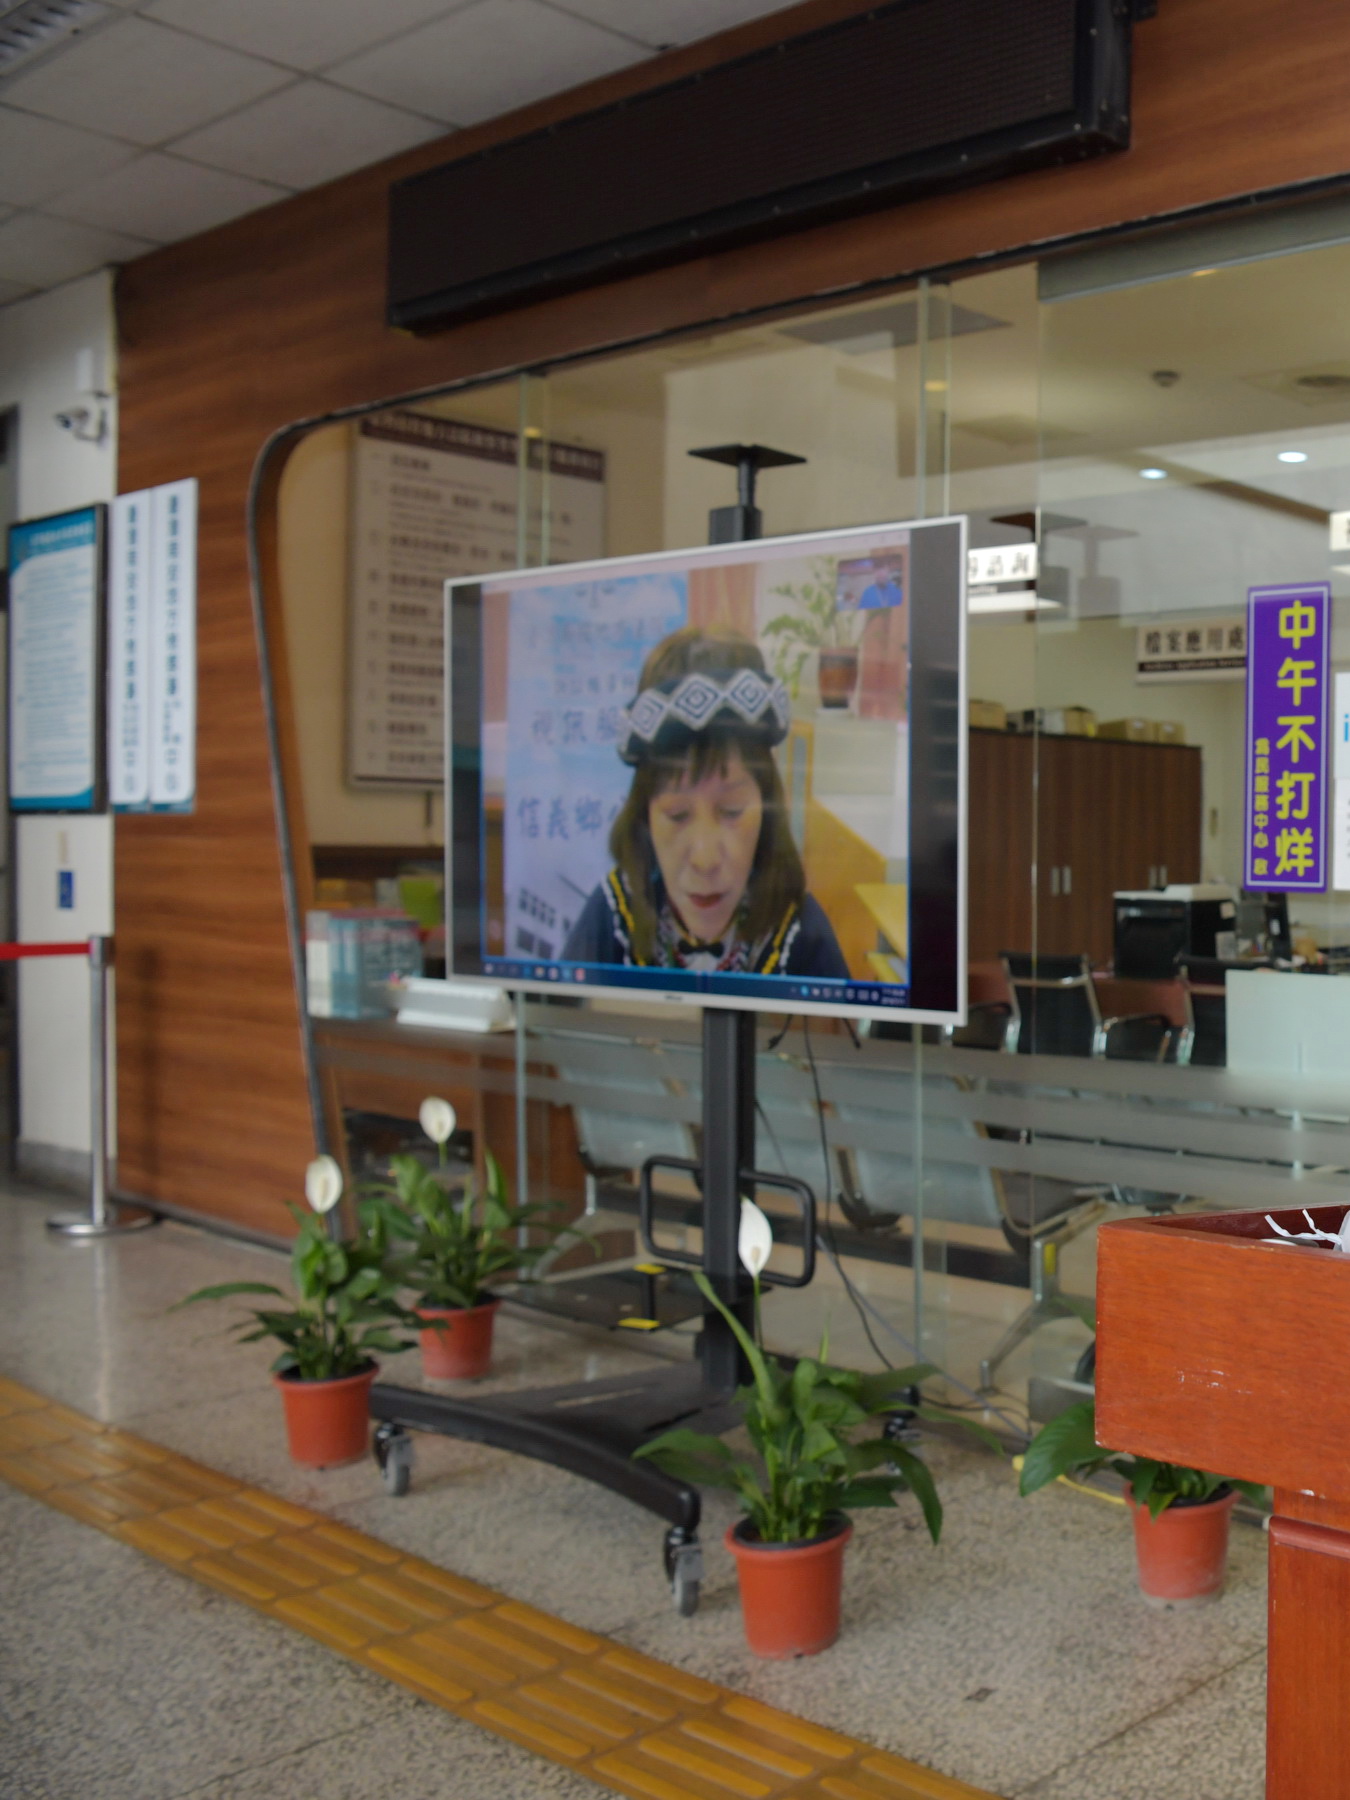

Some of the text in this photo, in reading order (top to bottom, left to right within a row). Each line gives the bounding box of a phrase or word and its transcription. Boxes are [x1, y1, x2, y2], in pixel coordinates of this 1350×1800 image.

[1275, 600, 1316, 876] 中午不打烊
